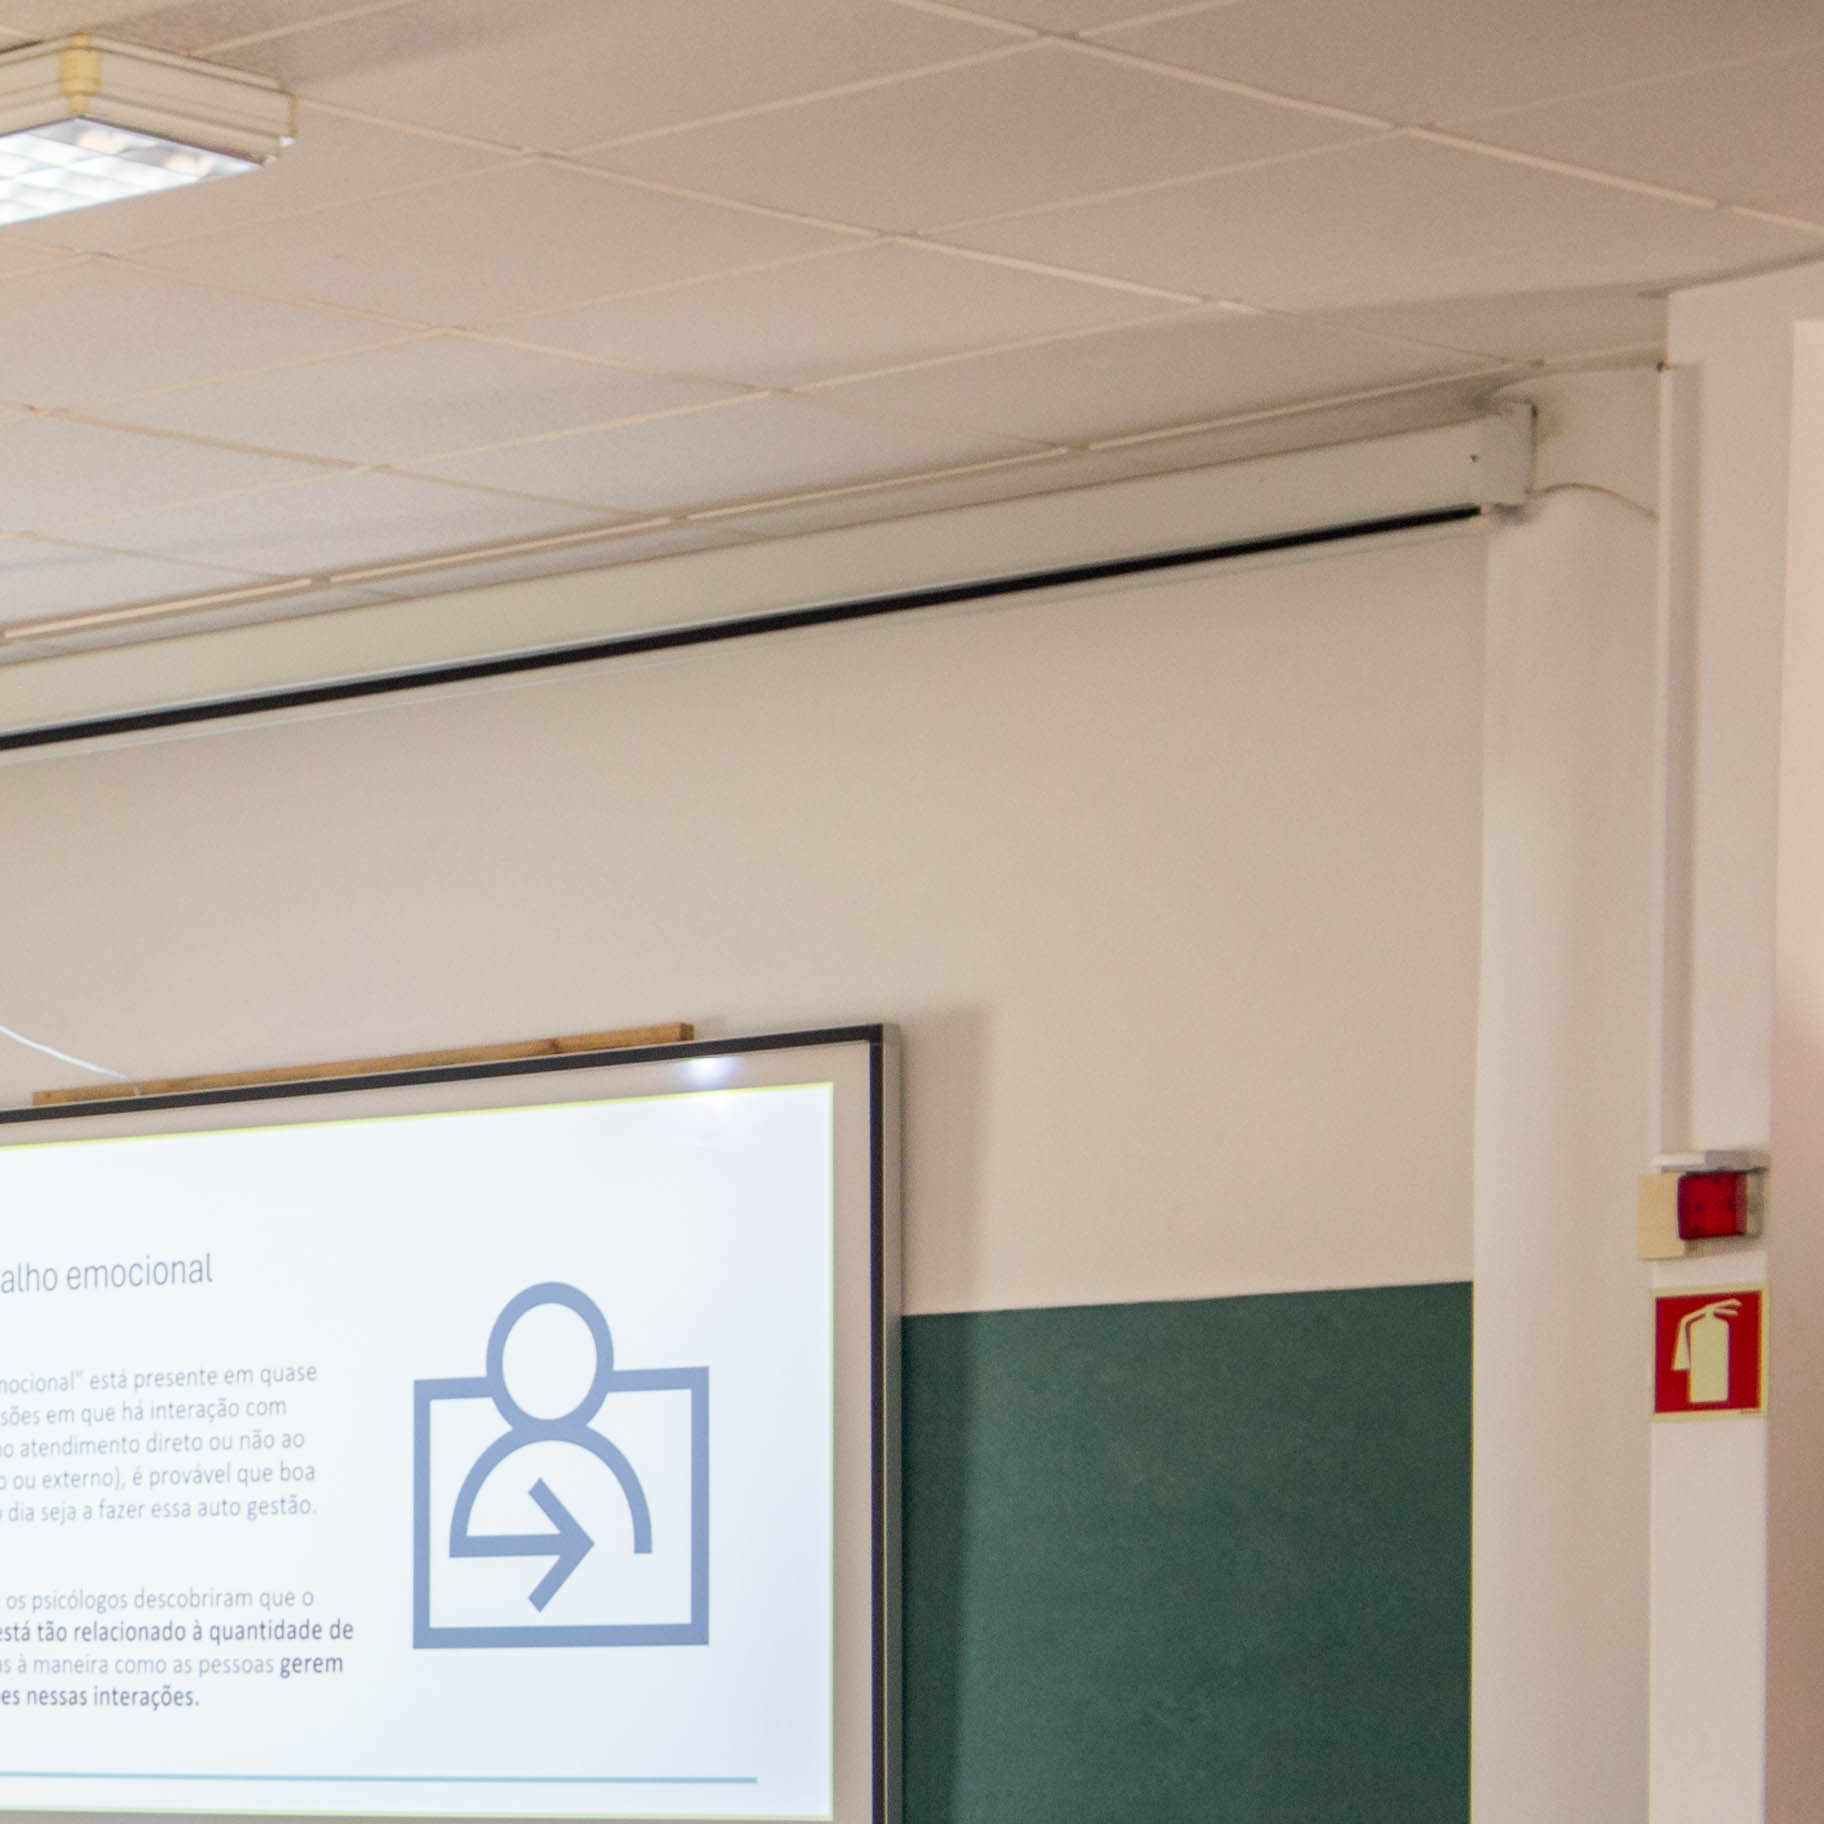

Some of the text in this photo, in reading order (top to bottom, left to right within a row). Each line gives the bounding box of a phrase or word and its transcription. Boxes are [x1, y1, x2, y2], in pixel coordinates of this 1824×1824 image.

[65, 1251, 214, 1291] emocional
[88, 1368, 128, 1391] está
[133, 1367, 219, 1393] presente
[223, 1368, 254, 1386] em
[259, 1365, 318, 1388] quase
[45, 1408, 75, 1425] em
[80, 1406, 117, 1427] que
[121, 1398, 145, 1422] há
[150, 1394, 241, 1424] interação
[245, 1399, 287, 1417] com
[19, 1435, 141, 1458] atendimento
[145, 1432, 204, 1454] direto
[208, 1435, 233, 1452] ou
[239, 1428, 276, 1451] não
[280, 1432, 306, 1450] ao
[12, 1474, 37, 1491] ou
[131, 1463, 144, 1487] é
[149, 1462, 231, 1490] provável
[236, 1466, 274, 1488] que
[279, 1459, 316, 1483] boa
[7, 1501, 36, 1523] dia
[40, 1505, 77, 1527] seja
[82, 1504, 93, 1521] a
[97, 1497, 146, 1521] fazer
[150, 1501, 192, 1519] essa
[196, 1498, 242, 1518] auto
[5, 1594, 27, 1611] os
[31, 1588, 129, 1616] psicólogos
[133, 1586, 254, 1610] descobriram
[258, 1591, 297, 1612] que
[301, 1590, 315, 1608] o
[36, 1619, 69, 1643] tão
[73, 1619, 187, 1643] relacionado
[191, 1618, 204, 1643] à
[208, 1617, 324, 1647] quantidade
[328, 1616, 355, 1641] de
[16, 1653, 28, 1675] à
[32, 1653, 109, 1675] maneira
[114, 1658, 168, 1675] como
[172, 1658, 193, 1675] as
[198, 1657, 275, 1679] pessoas
[278, 1656, 344, 1680] gerem
[25, 1688, 89, 1708] nessas
